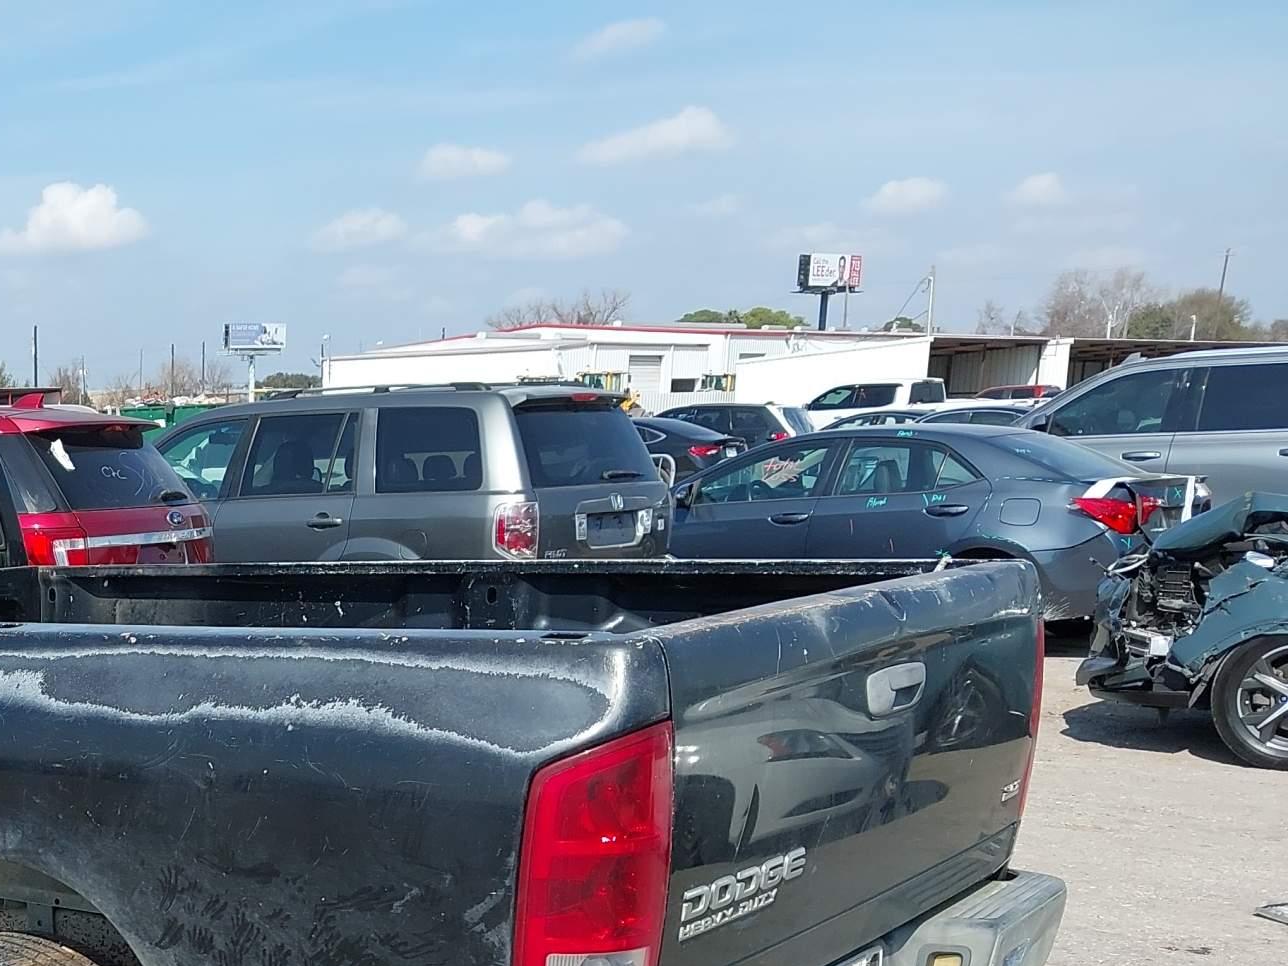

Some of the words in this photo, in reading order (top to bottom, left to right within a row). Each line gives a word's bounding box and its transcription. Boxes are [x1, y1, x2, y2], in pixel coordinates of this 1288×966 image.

[678, 906, 735, 942] HEAVY
[738, 887, 779, 917] DUTY
[680, 846, 807, 922] DODGE
